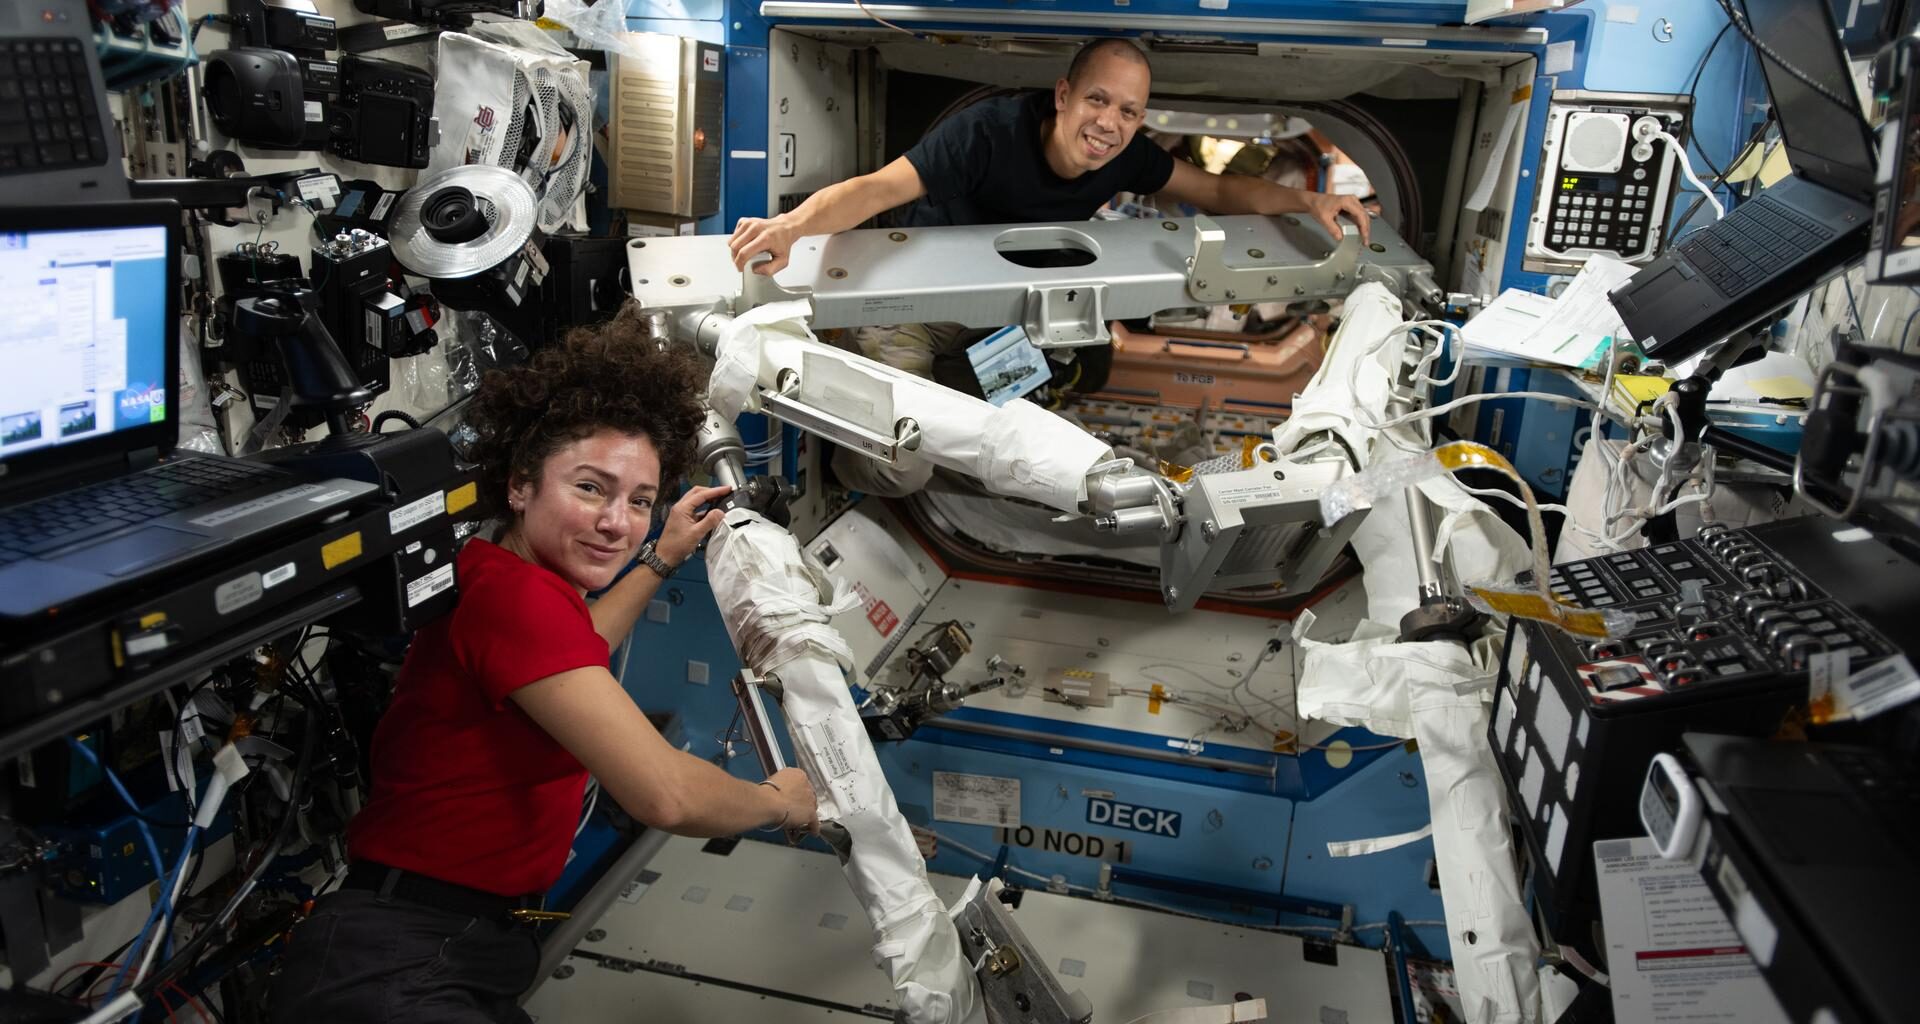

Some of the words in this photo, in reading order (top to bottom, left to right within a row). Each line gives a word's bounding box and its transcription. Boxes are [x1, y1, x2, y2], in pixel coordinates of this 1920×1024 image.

[1191, 374, 1214, 384] FGB
[1089, 800, 1179, 836] DECK
[1043, 829, 1104, 858] NOD
[1114, 841, 1125, 863] 1
